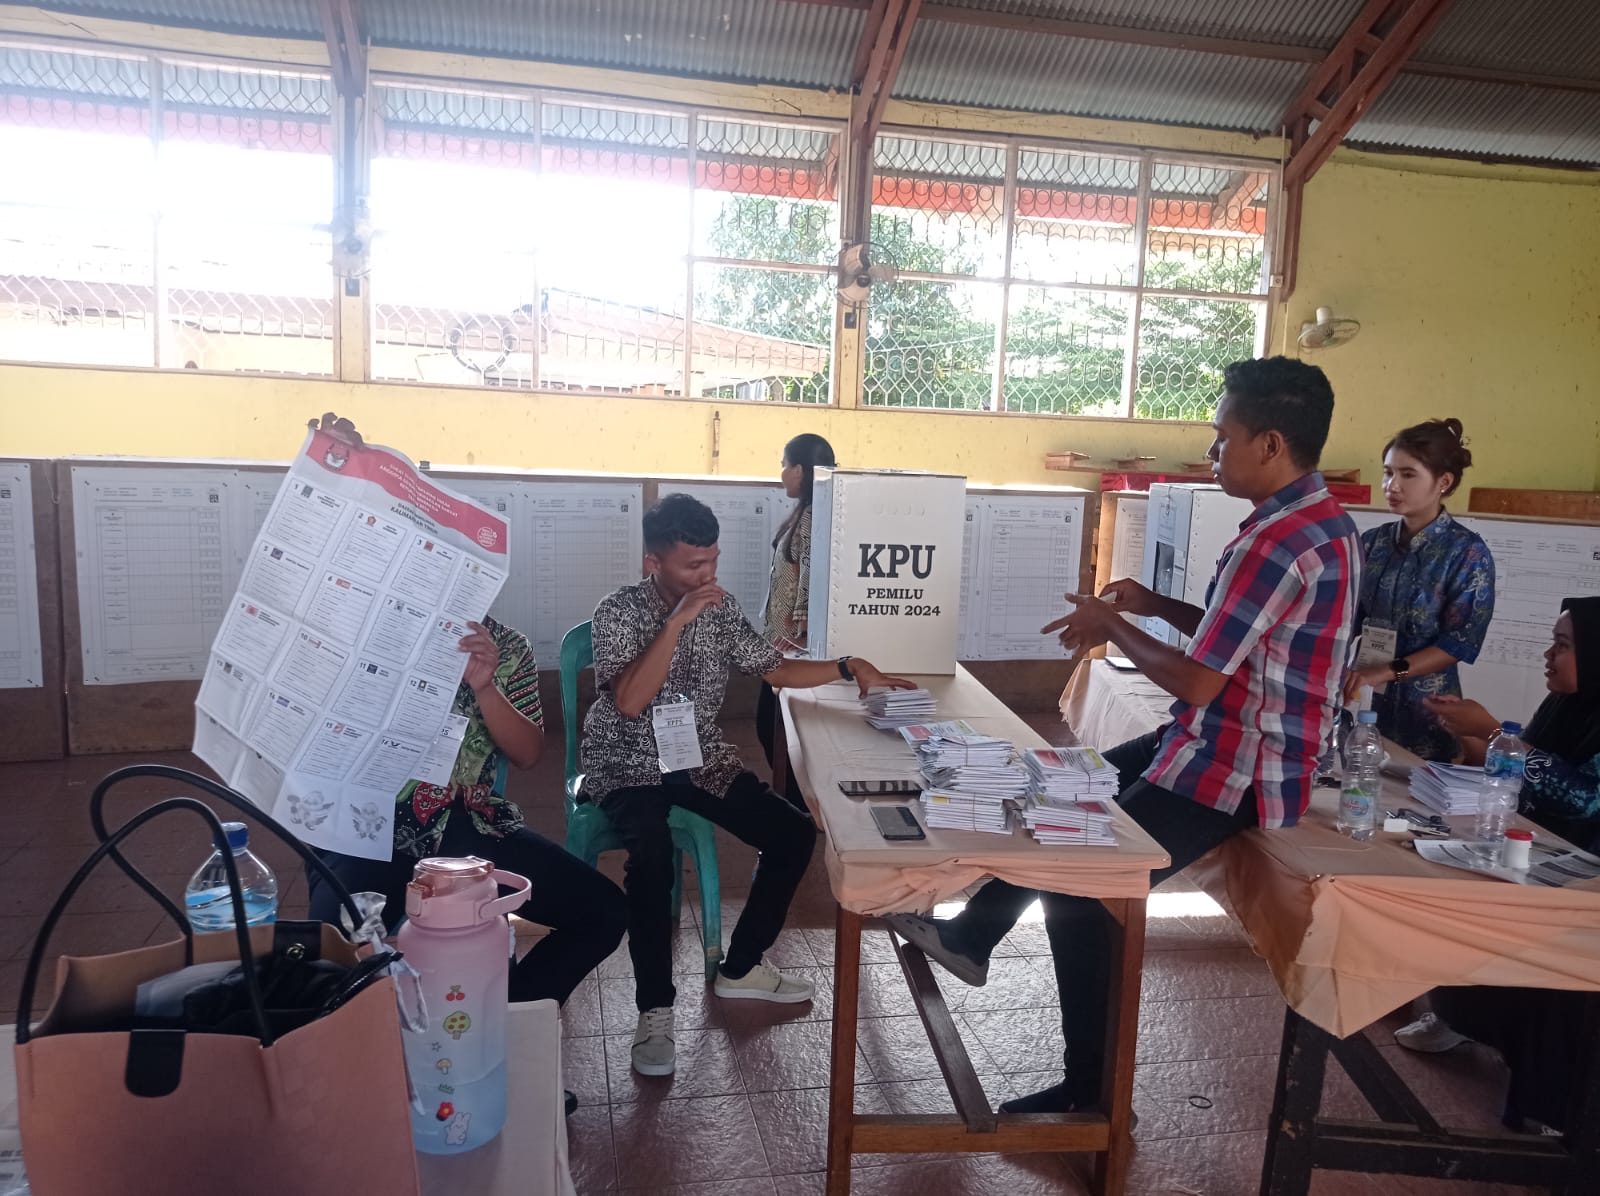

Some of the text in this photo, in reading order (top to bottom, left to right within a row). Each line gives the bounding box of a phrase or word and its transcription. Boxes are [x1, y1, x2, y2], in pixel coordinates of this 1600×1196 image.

[857, 543, 936, 579] KPU
[867, 588, 924, 599] PEMILU
[848, 604, 941, 616] TAHUN 2024
